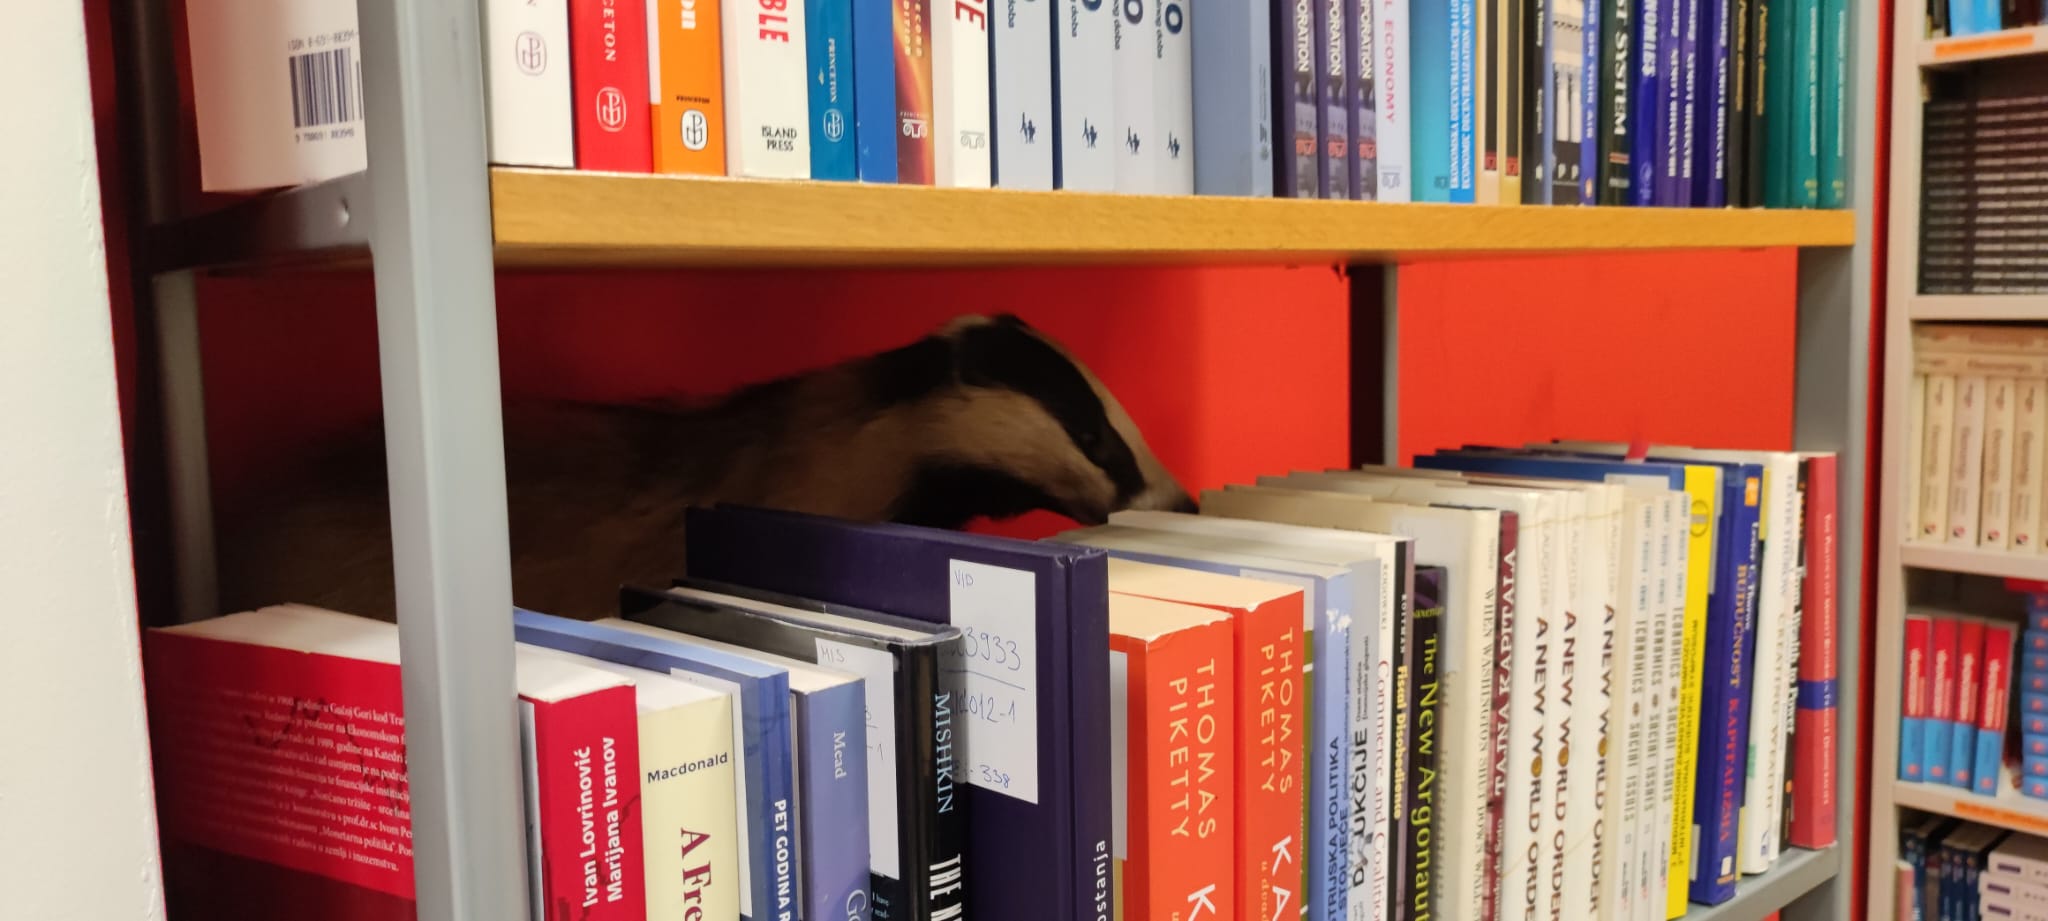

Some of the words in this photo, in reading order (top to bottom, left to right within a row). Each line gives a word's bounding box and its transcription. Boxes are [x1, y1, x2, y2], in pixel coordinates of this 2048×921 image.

[827, 37, 838, 103] PRINCETON
[1384, 19, 1395, 125] ECONOMY
[1613, 31, 1628, 136] SYSTEM
[760, 125, 798, 140] ISLAND
[766, 138, 795, 153] PRESS
[1482, 587, 1495, 637] WHEN
[1498, 548, 1517, 697] KAPITALA
[1535, 617, 1549, 638] A
[1564, 611, 1577, 632] A
[1603, 604, 1615, 624] A
[1669, 606, 1684, 679] ECONOMICS
[1423, 634, 1438, 675] The
[1533, 644, 1548, 715] NEW
[1561, 637, 1576, 706] NEW
[1600, 630, 1614, 697] NEW
[1631, 620, 1647, 695] ECONOMICS
[1651, 612, 1666, 687] ECONOMICS
[1260, 644, 1275, 793] PIKETTY
[1279, 627, 1293, 794] THOMAS
[1374, 660, 1390, 777] Commerce
[1397, 665, 1409, 709] Fiscal
[1418, 681, 1440, 756] New
[1479, 643, 1493, 752] WASHINGTON
[602, 736, 618, 808] Ivanov
[647, 751, 728, 784] Macdonald
[833, 731, 847, 780] Mead
[934, 692, 954, 815] MISHKIN
[1168, 677, 1190, 838] PIKETTY
[1195, 658, 1216, 839] THOMAS
[1328, 735, 1339, 830] POLITIKA
[1393, 713, 1407, 821] Disobedience
[1494, 703, 1510, 796] TAJNA
[1719, 698, 1740, 842] KAPITALIZMA
[573, 745, 597, 858] Lovrinović
[774, 799, 788, 832] PET
[1374, 786, 1387, 825] and
[604, 809, 625, 903] Marijana
[680, 828, 711, 859] A
[775, 836, 791, 909] GODINA
[929, 853, 962, 900] THE
[1327, 834, 1338, 921] TRIJSKA
[582, 860, 599, 908] Ivan
